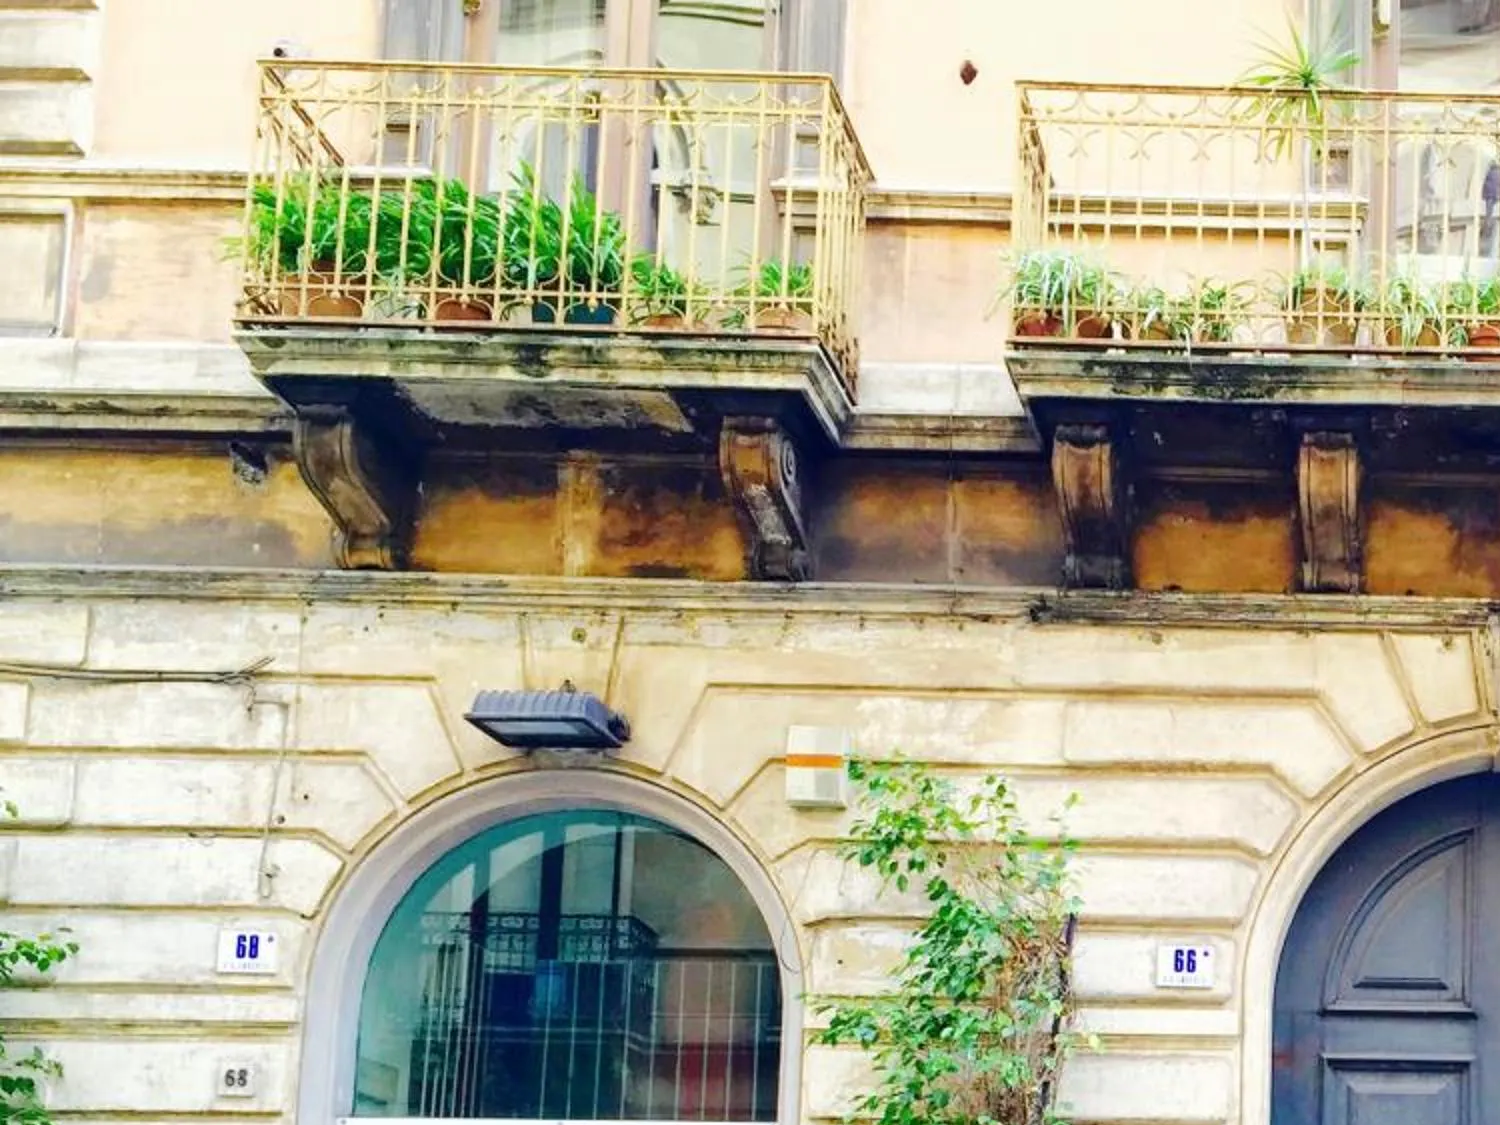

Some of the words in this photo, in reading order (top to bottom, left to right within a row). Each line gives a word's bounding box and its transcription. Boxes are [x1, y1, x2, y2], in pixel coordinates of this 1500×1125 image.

[236, 934, 259, 959] 68
[1174, 949, 1197, 973] 66
[224, 1069, 248, 1087] 68
